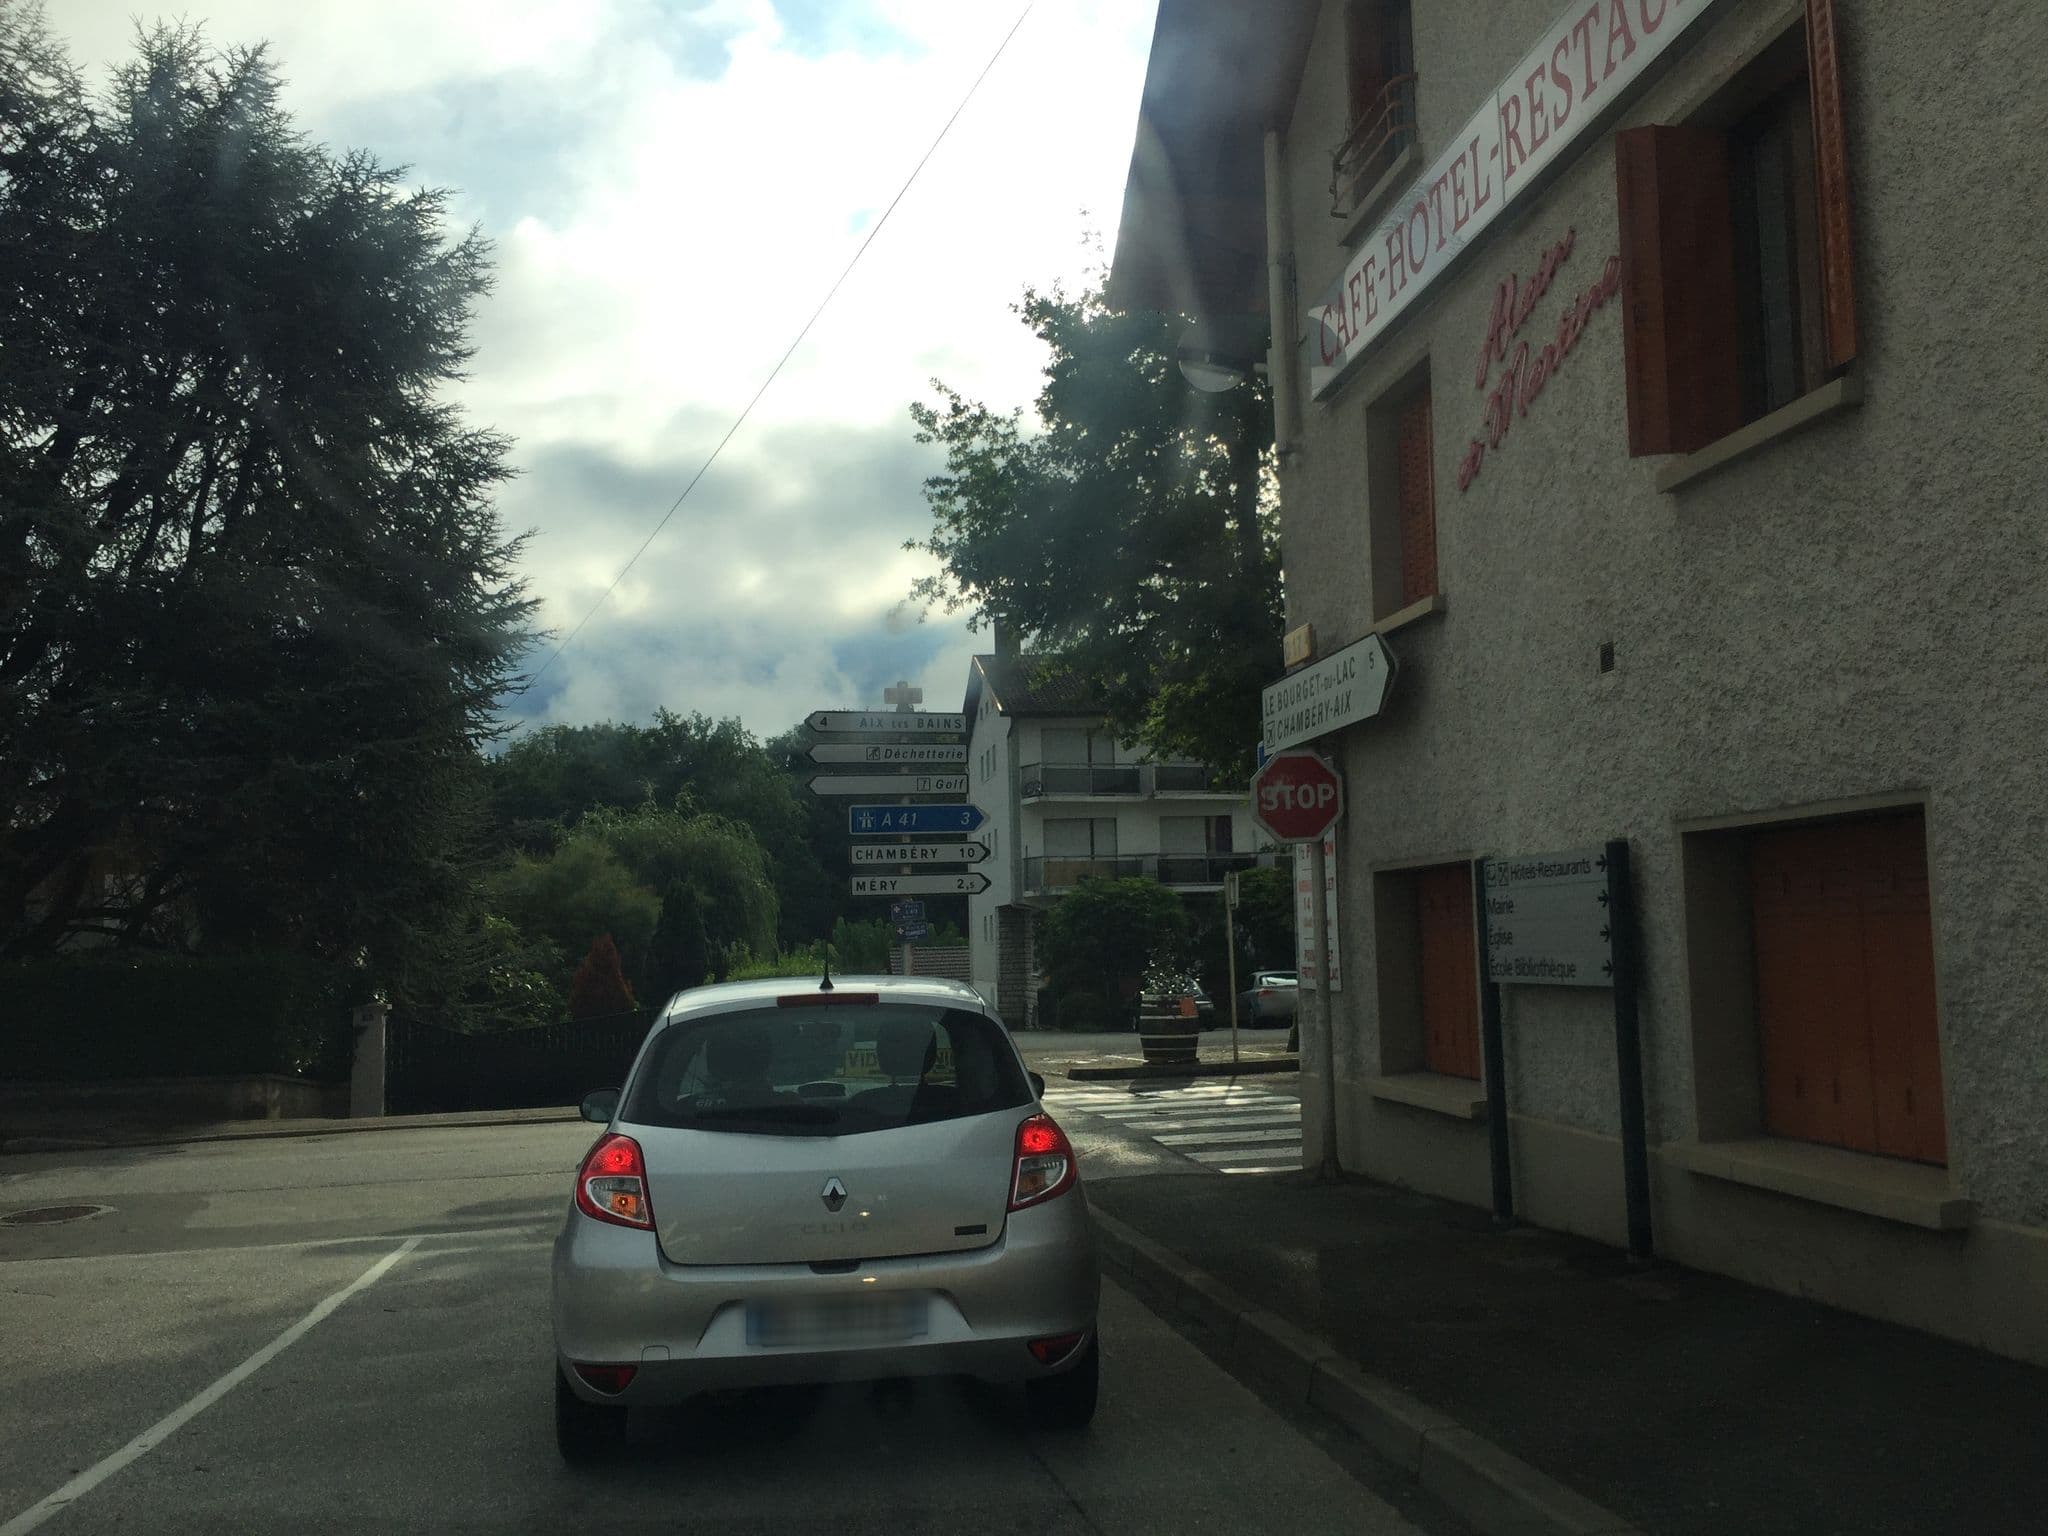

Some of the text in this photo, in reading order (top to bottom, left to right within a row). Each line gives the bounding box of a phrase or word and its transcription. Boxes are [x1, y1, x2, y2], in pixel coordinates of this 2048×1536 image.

[1264, 692, 1275, 718] LE
[1368, 651, 1376, 671] 5
[819, 716, 828, 727] 4
[859, 718, 883, 729] AIX
[917, 718, 963, 730] BAINS
[884, 748, 964, 760] Déchetterie
[935, 777, 965, 790] Golf
[1260, 781, 1337, 812] STOP
[880, 811, 971, 827] A 41 3
[855, 846, 976, 861] CHAMBÉRY 10
[855, 878, 976, 892] MÉRY 2,5
